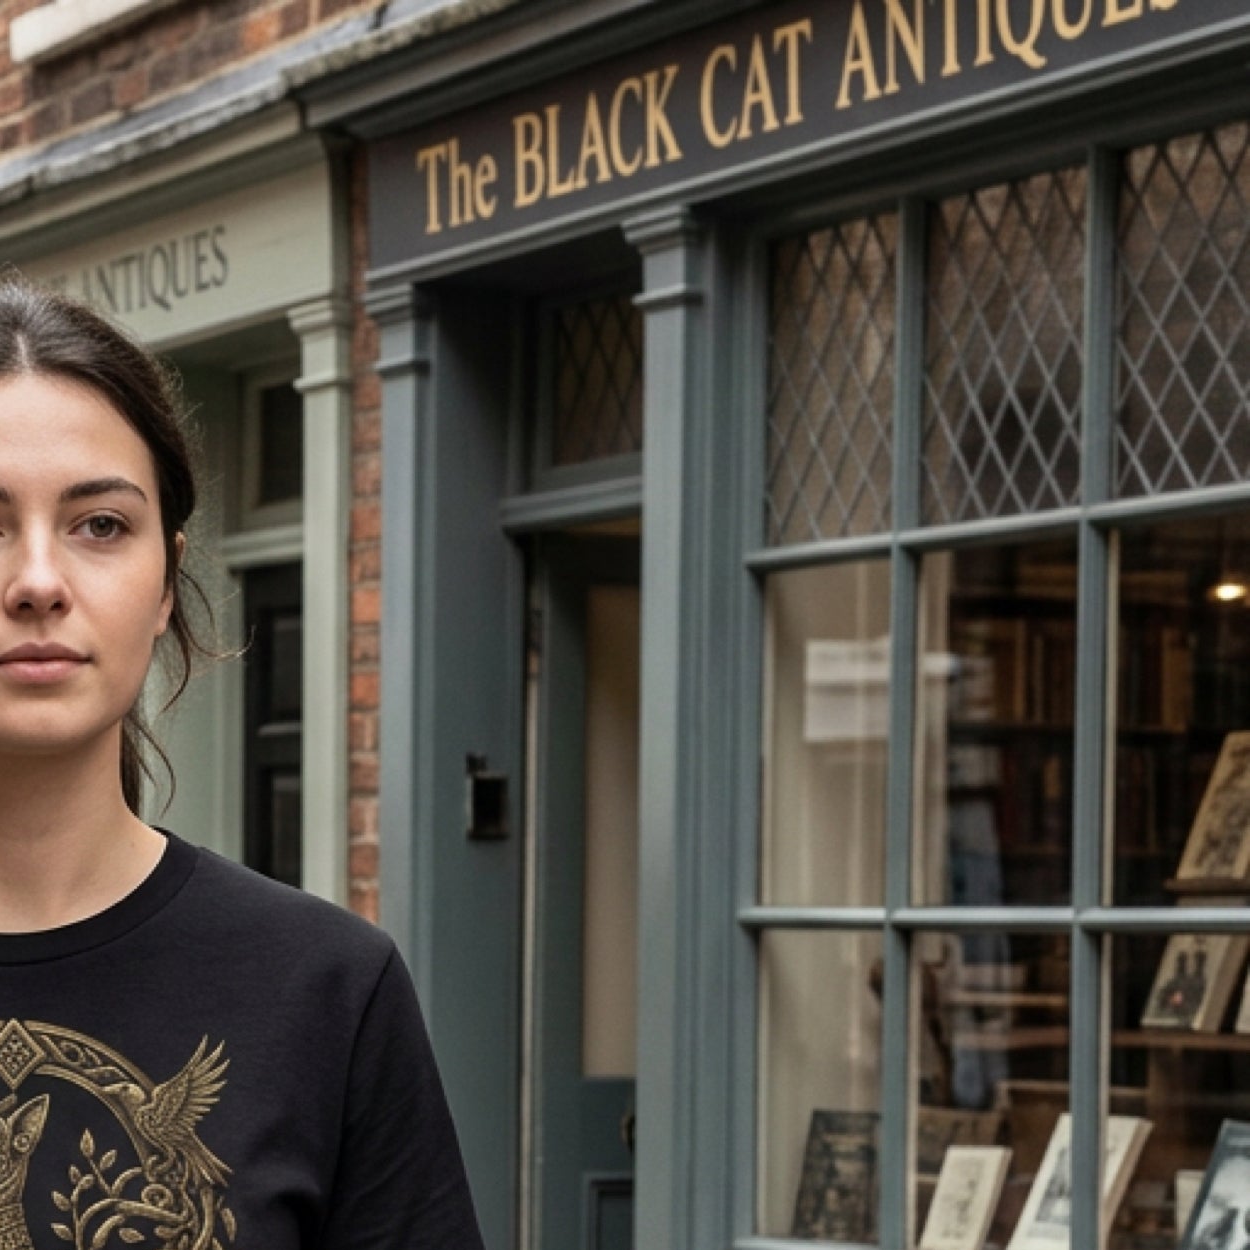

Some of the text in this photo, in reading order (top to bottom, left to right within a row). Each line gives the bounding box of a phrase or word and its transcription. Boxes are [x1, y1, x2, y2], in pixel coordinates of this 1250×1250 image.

[417, 137, 498, 234] The
[513, 64, 682, 209] BLACK
[700, 17, 812, 148] CAT
